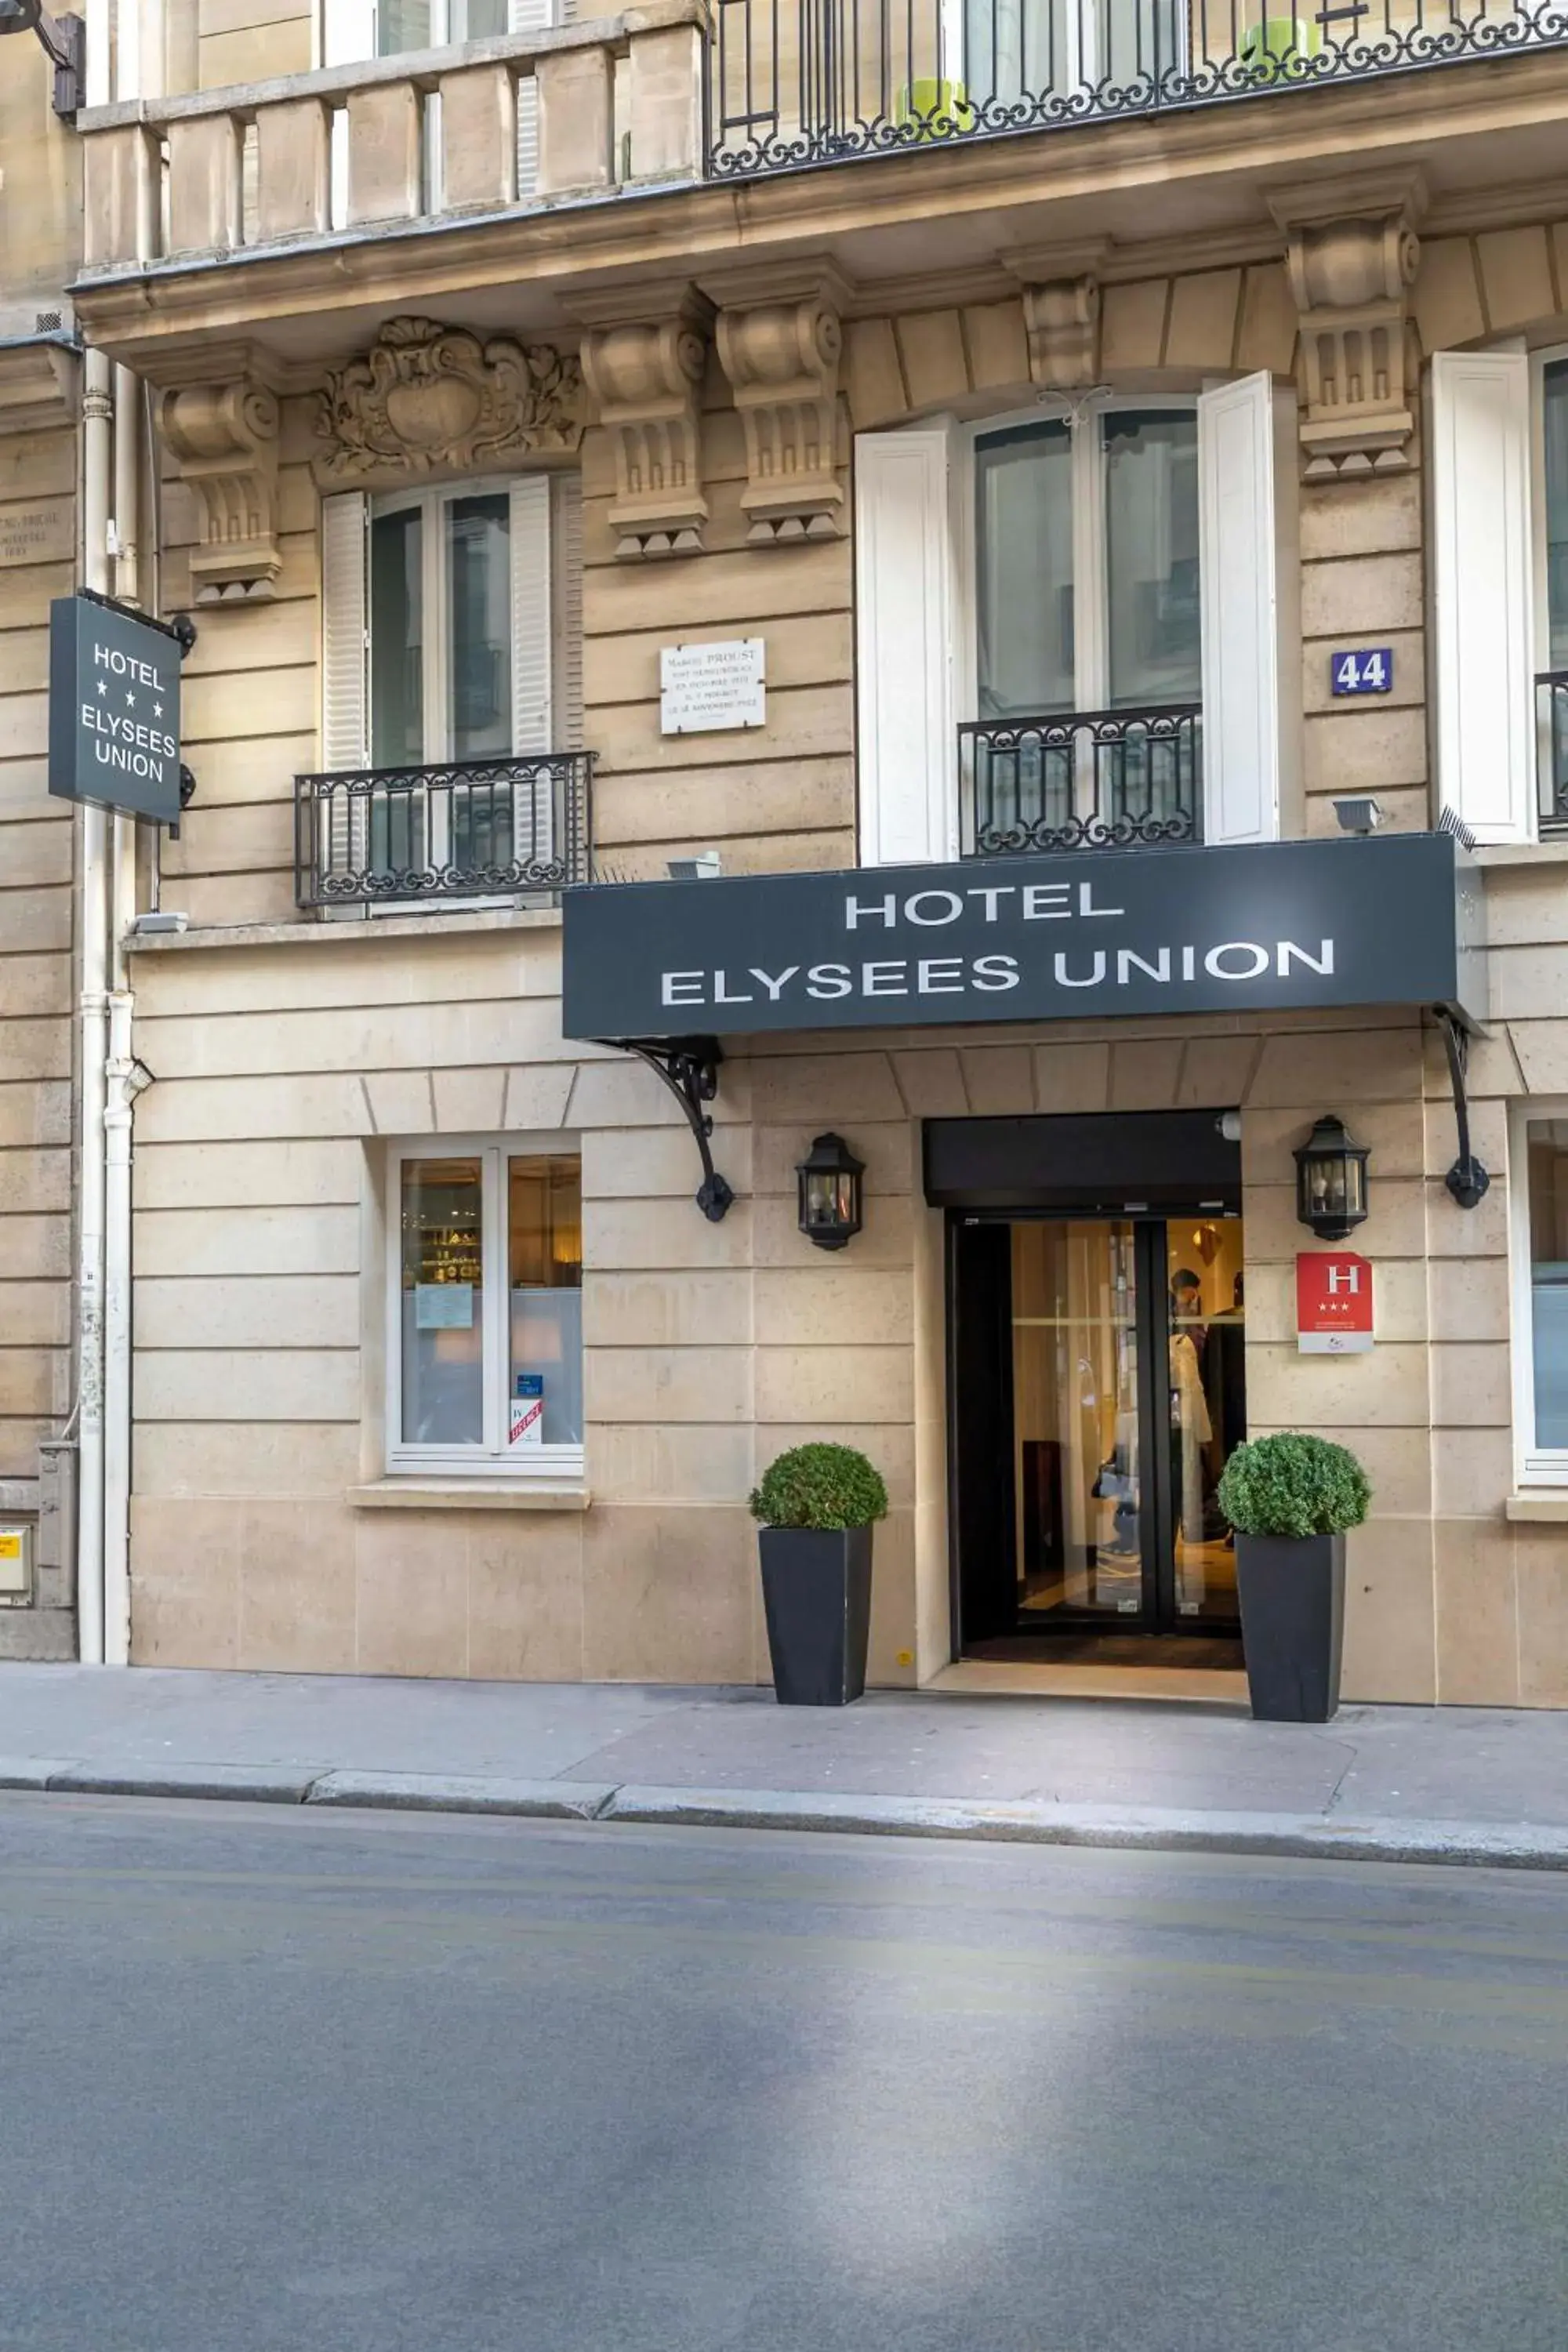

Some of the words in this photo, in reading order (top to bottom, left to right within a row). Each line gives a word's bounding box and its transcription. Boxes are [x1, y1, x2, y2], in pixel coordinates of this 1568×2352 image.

[94, 643, 165, 691] HOTEL
[1338, 653, 1385, 688] 44
[82, 703, 176, 757] ELYSEES
[95, 739, 163, 783] UNION
[846, 882, 1125, 929] HOTEL
[661, 955, 1020, 1006] ELYSEES
[1054, 939, 1334, 988] UNION
[1326, 1265, 1362, 1294] H
